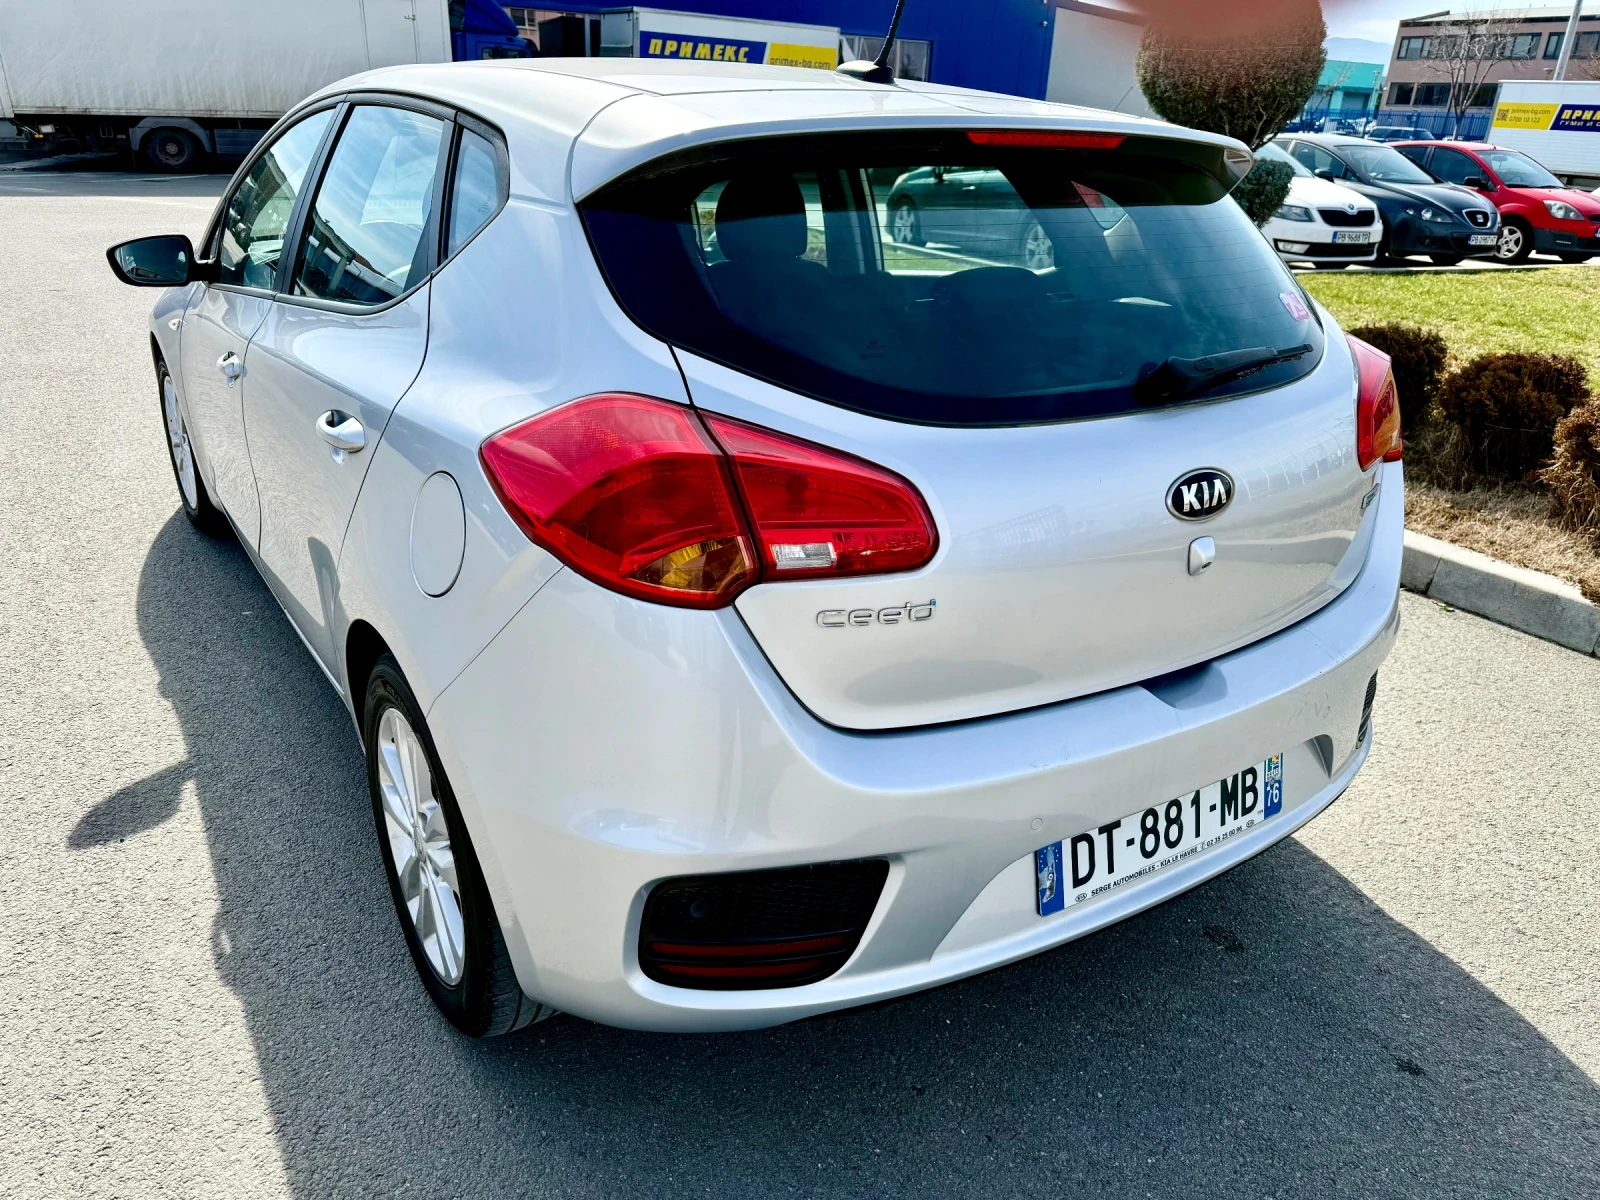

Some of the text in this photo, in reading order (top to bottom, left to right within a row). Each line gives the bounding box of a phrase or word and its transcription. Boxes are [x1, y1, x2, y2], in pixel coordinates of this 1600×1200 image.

[648, 38, 750, 63] ПРИМЕКС
[1180, 479, 1227, 512] KIA
[816, 598, 937, 628] cee'd
[1266, 782, 1280, 807] 76
[1070, 766, 1259, 889] DT-881-MB
[1091, 883, 1112, 896] SERGE
[1113, 864, 1156, 887] AUTOMOBILES
[1160, 859, 1171, 867] KIA
[1180, 847, 1198, 859] HAVRE
[1214, 835, 1221, 843] 35
[1222, 832, 1229, 840] 25
[1228, 829, 1236, 837] 00
